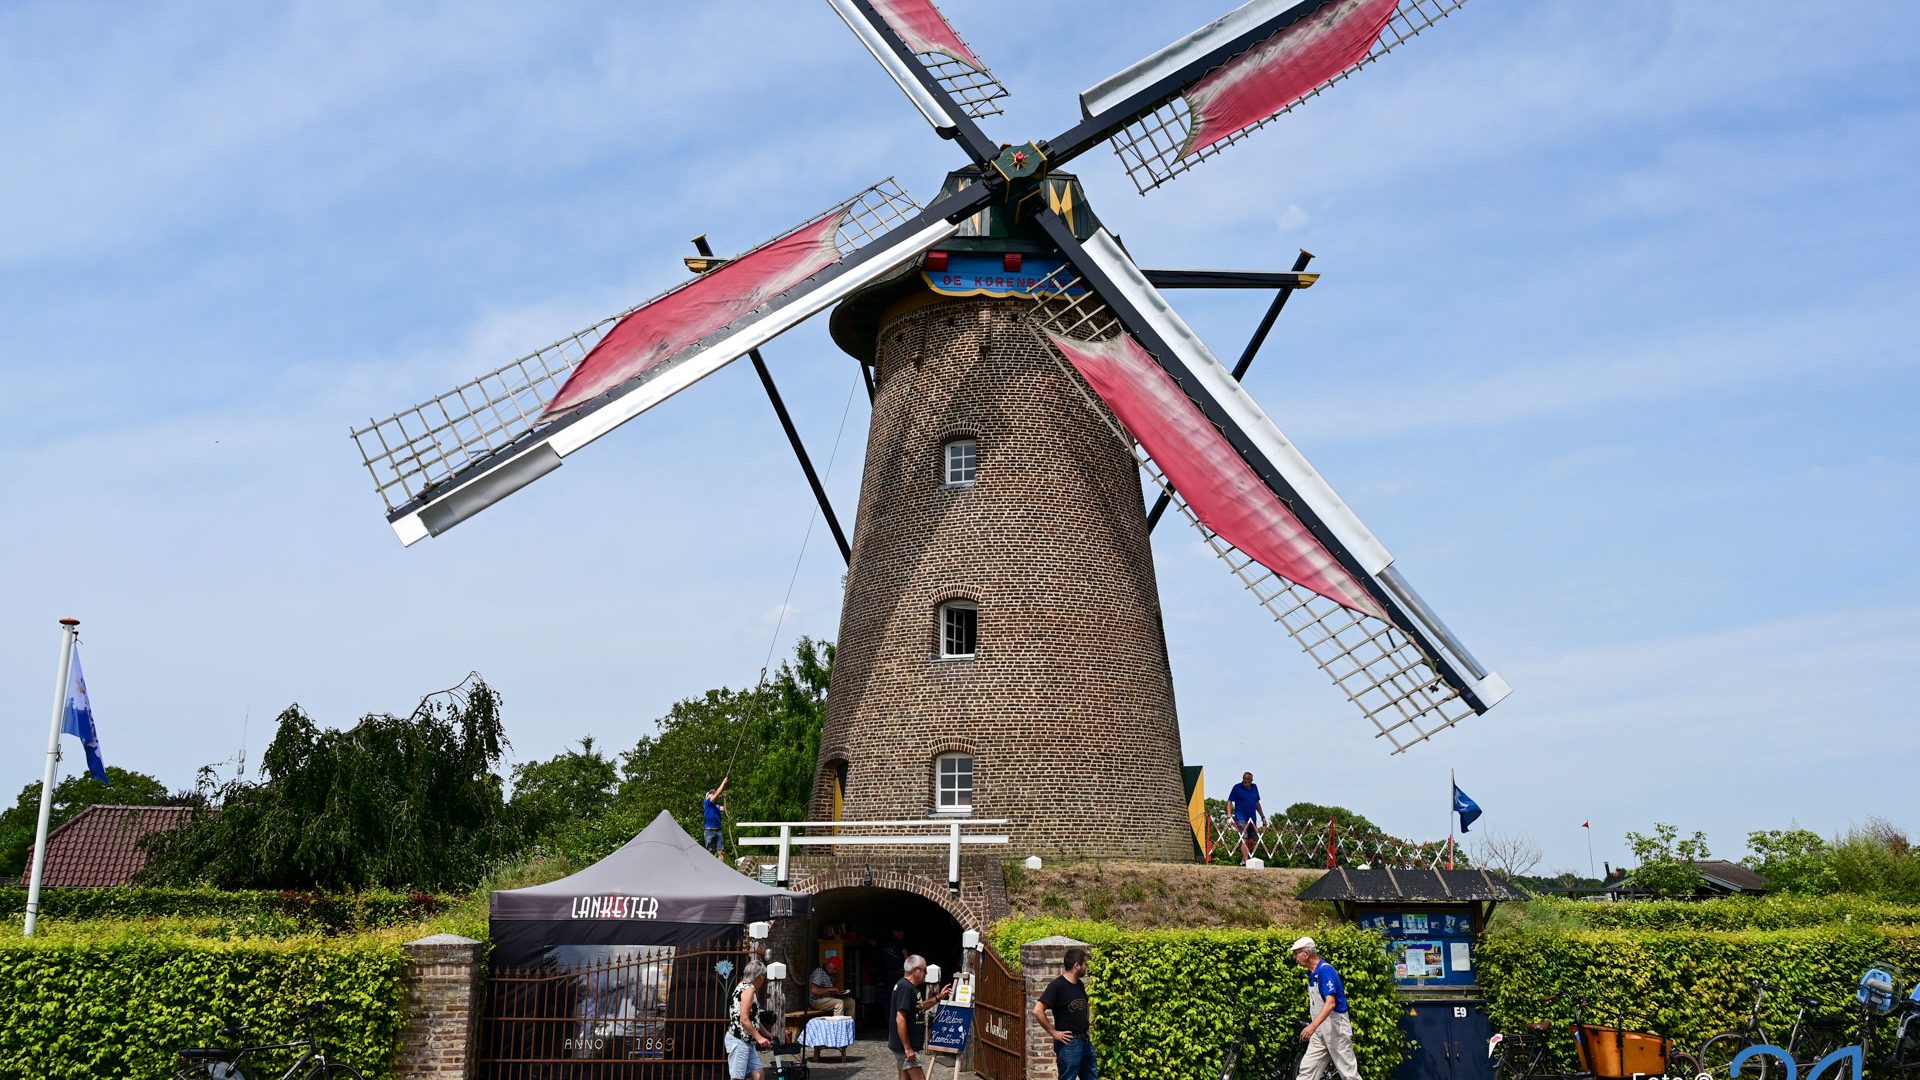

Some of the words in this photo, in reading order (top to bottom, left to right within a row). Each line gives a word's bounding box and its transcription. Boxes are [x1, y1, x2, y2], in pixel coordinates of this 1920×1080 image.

[943, 275, 962, 286] DE
[571, 896, 659, 919] LANKESTER
[1453, 1006, 1468, 1018] E9
[564, 1038, 604, 1050] ANNO
